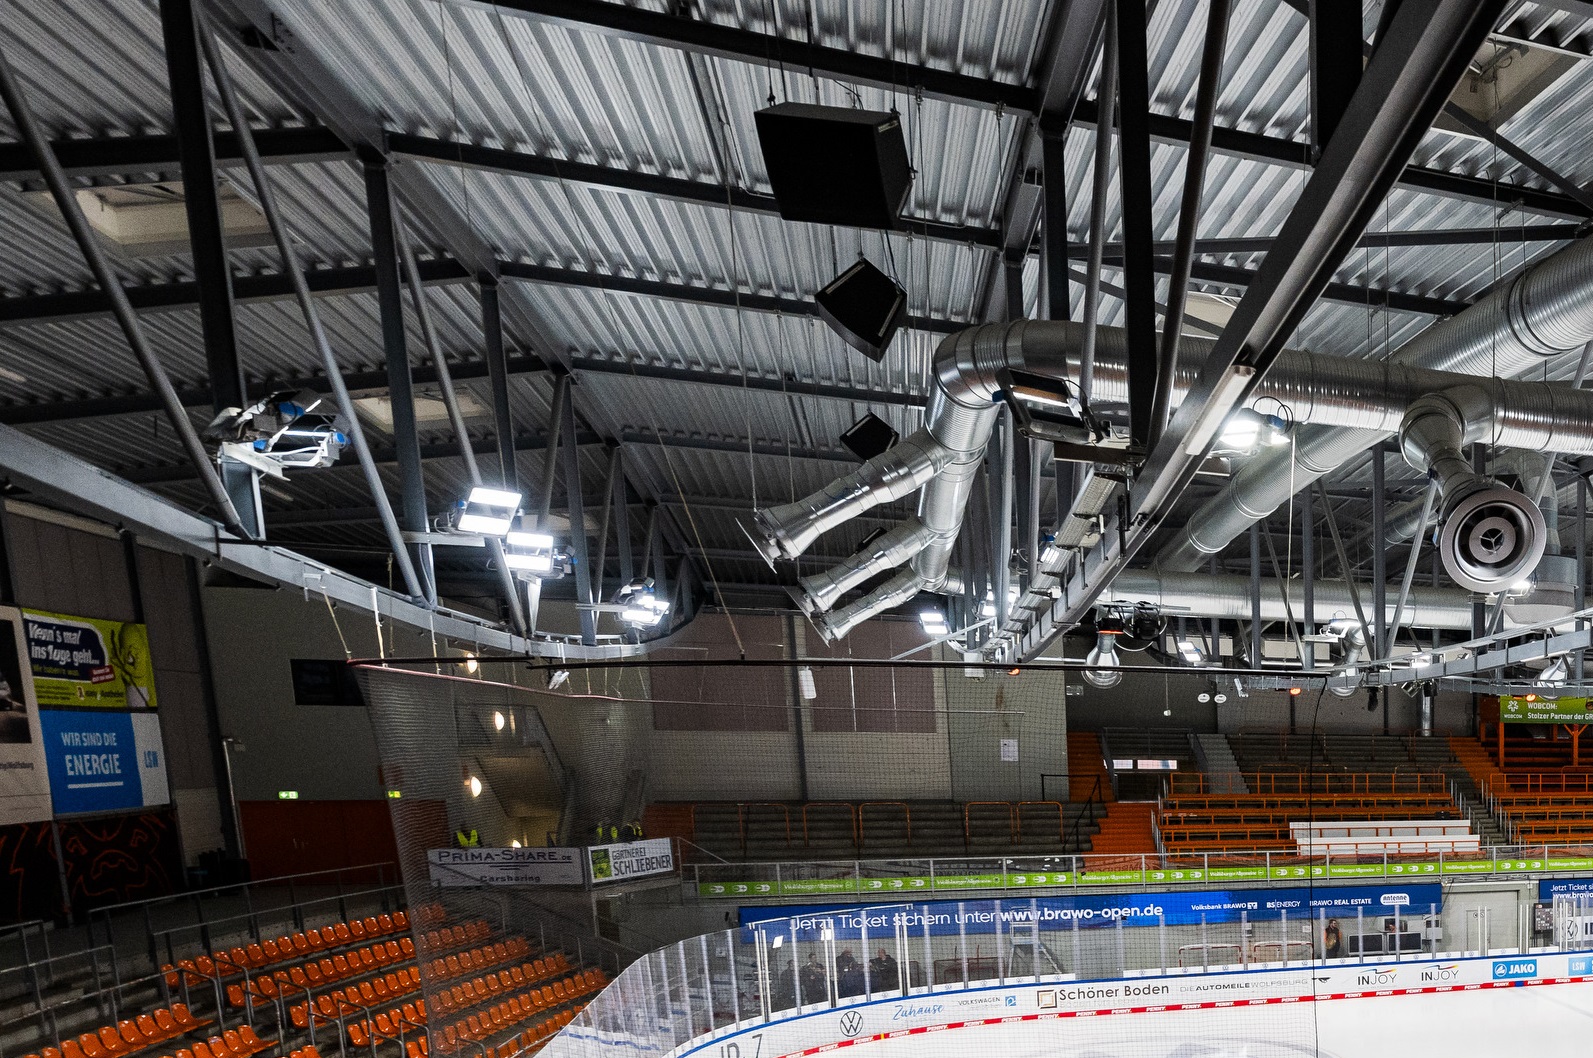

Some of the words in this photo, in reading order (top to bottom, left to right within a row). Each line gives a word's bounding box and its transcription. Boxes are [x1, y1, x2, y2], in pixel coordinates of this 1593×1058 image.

[63, 630, 81, 644] mal
[31, 642, 46, 658] ins
[1550, 713, 1573, 721] Partner
[61, 732, 81, 746] WIR
[82, 732, 102, 746] SIND
[104, 733, 117, 746] DIE
[65, 754, 121, 776] ENERGIE
[438, 851, 557, 862] PRIMA-SHARE
[613, 855, 672, 876] SCHLIEBENER
[1550, 884, 1567, 892] Jetzt
[790, 917, 833, 930] Jetzt
[838, 915, 888, 928] Ticket
[893, 912, 950, 927] sichern
[955, 911, 996, 924] unter
[1000, 904, 1163, 924] www.brawo-open.de
[1508, 963, 1535, 974] JAKO
[1572, 961, 1586, 971] LSW
[1357, 974, 1398, 986] INJOY
[1421, 969, 1459, 982] INJOY
[1059, 987, 1119, 1001] Schöner
[1124, 984, 1169, 997] Boden
[958, 997, 1001, 1006] VOLKSWAGEN
[893, 1004, 944, 1021] Zuhause
[752, 1033, 763, 1058] 7
